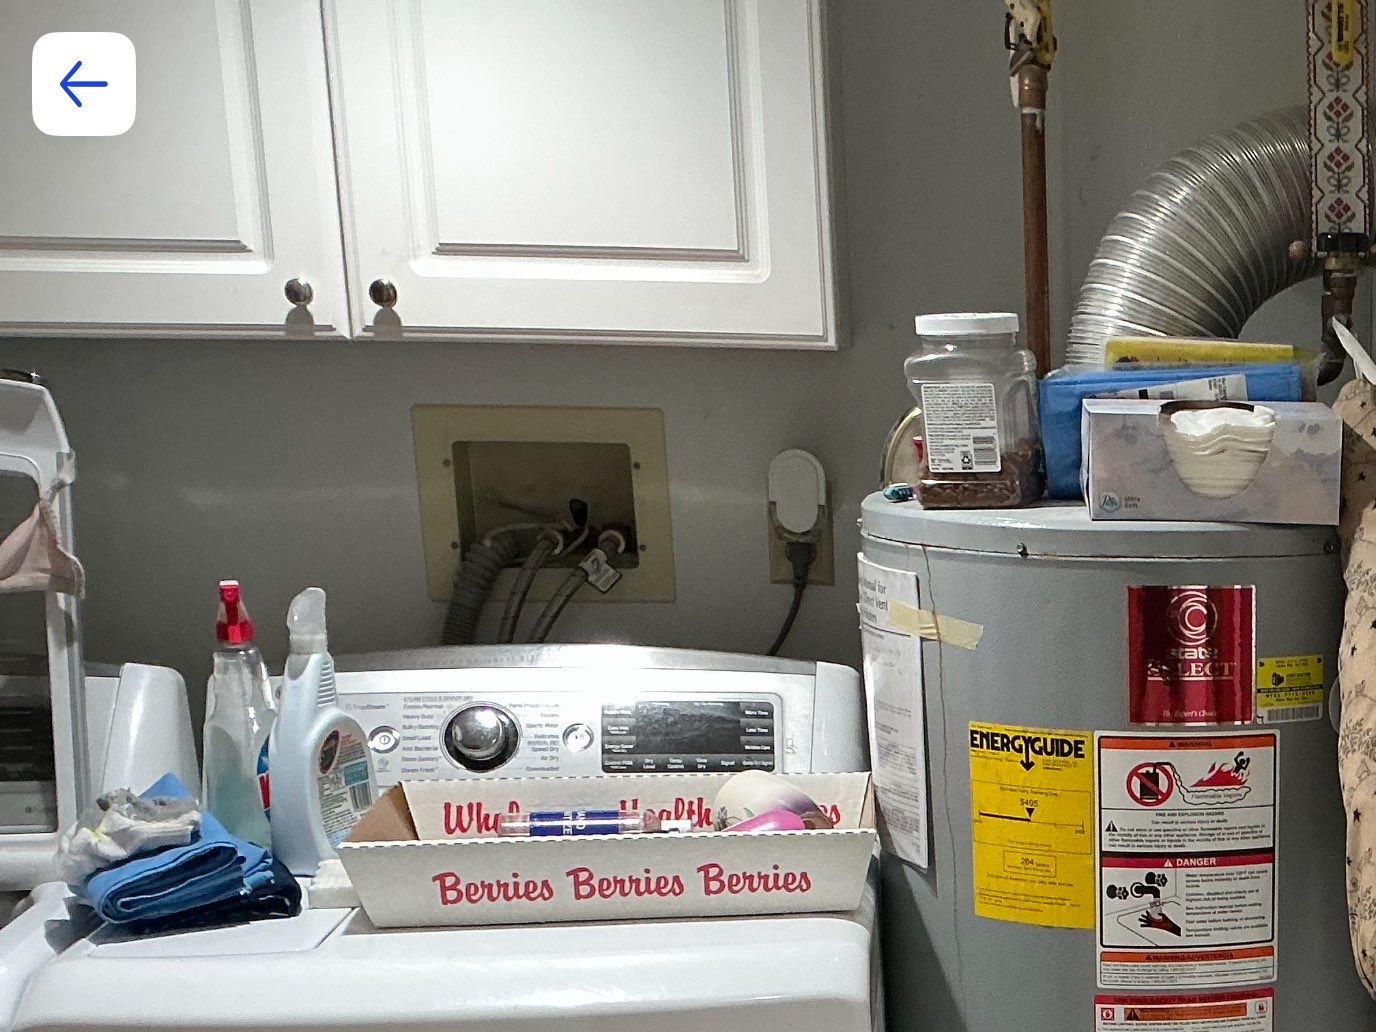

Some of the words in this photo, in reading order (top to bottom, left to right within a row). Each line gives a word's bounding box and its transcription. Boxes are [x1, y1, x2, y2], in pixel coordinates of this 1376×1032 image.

[969, 729, 1085, 759] ENERGYGUIDE
[1176, 858, 1217, 867] DANGER
[433, 872, 554, 905] Berries
[566, 867, 684, 900] Berries
[697, 863, 812, 896] Berries
